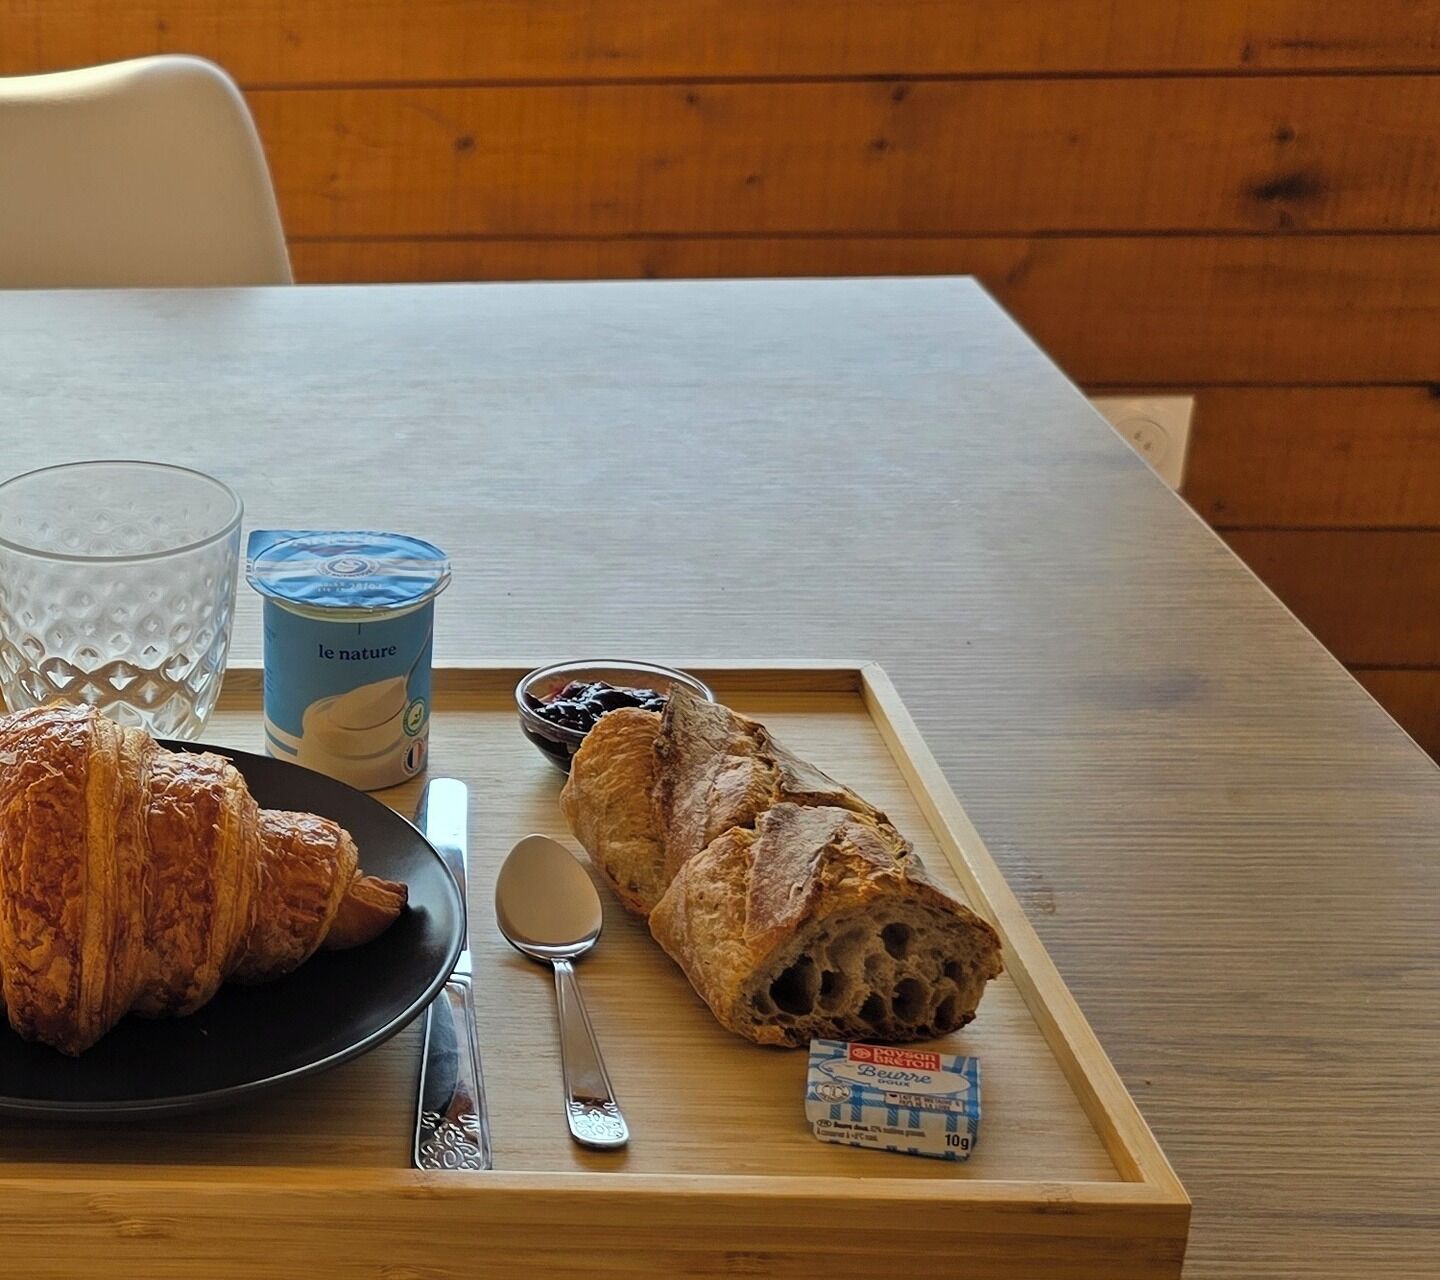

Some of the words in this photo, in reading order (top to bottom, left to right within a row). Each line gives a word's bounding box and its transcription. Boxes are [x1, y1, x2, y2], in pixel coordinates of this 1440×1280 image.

[317, 644, 335, 660] le
[338, 644, 397, 661] nature
[857, 1063, 932, 1084] Beurre
[944, 1133, 969, 1151] 10g
